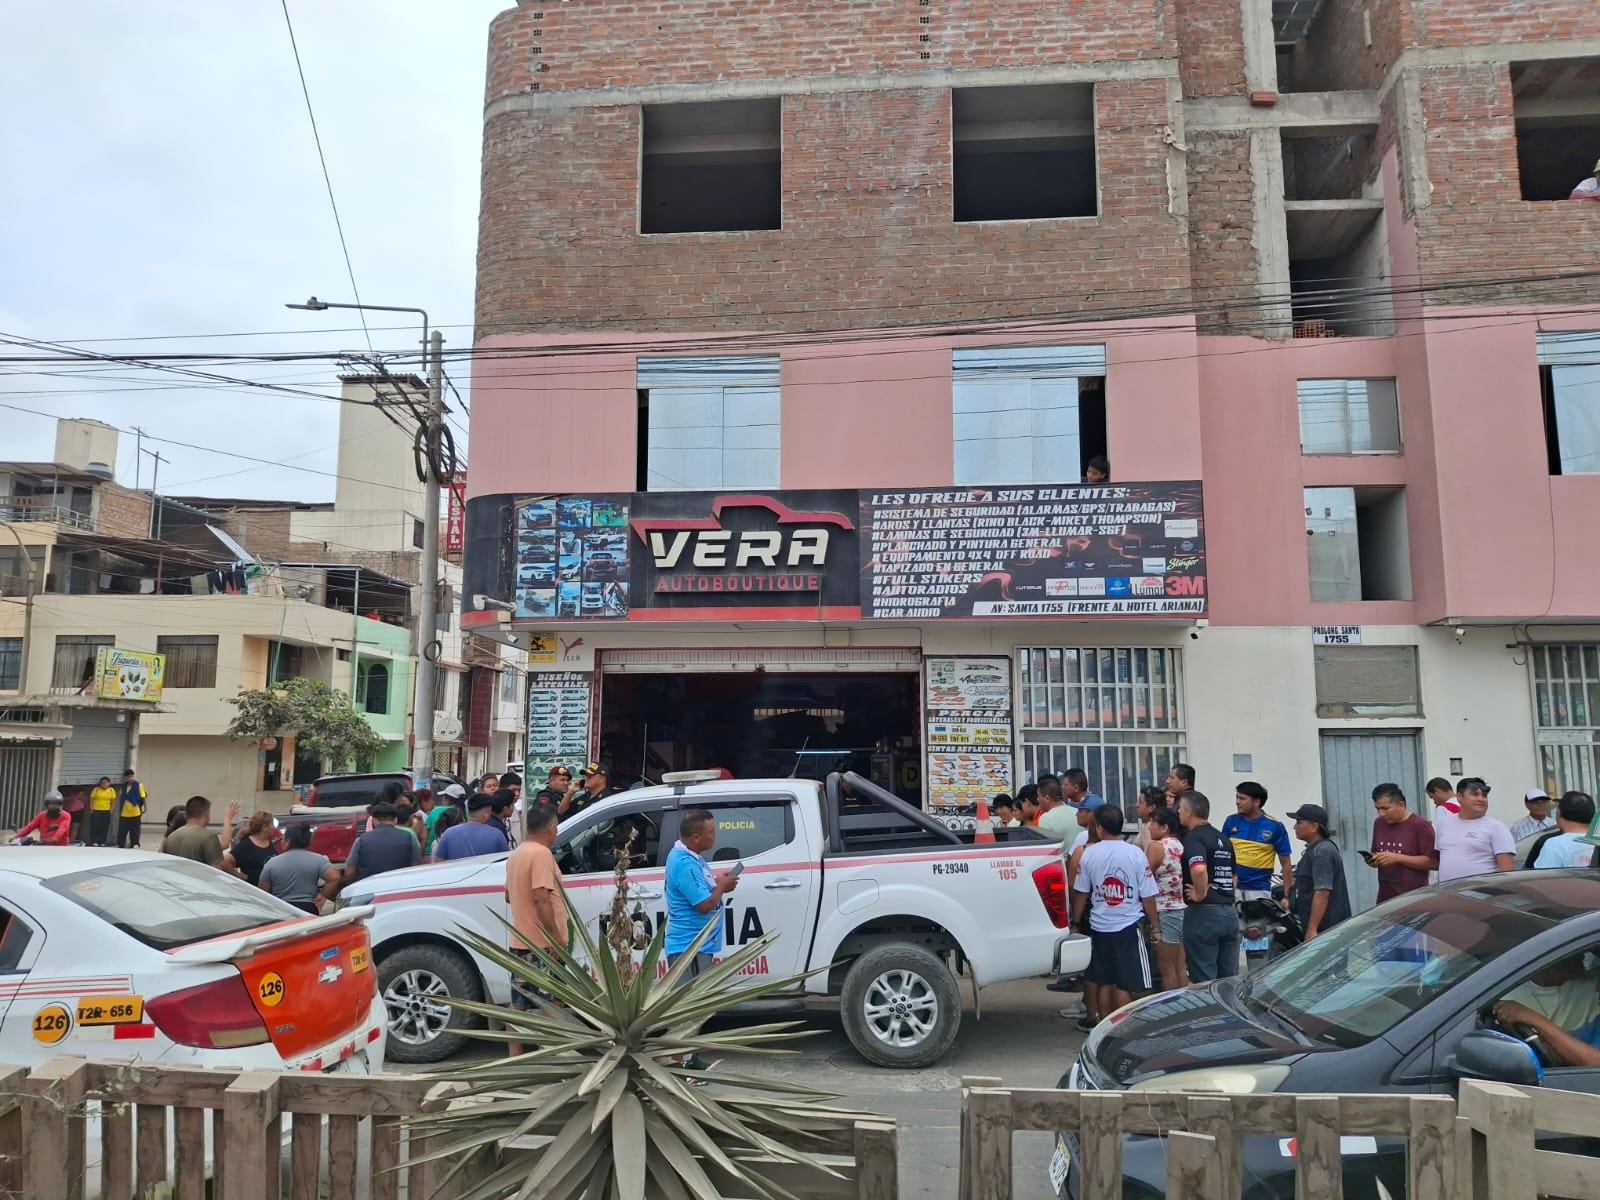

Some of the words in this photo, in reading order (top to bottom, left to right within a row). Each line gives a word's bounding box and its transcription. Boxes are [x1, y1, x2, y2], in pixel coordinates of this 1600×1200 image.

[872, 494, 905, 505] LES
[908, 492, 976, 504] OFRECE
[982, 490, 992, 502] A
[997, 490, 1034, 501] SUS
[1038, 487, 1130, 500] CLIENTES:
[873, 508, 932, 520] #SISTEMA
[932, 508, 948, 518] DE
[950, 506, 1015, 518] SEGURIDAD
[872, 520, 910, 530] #AROS
[912, 520, 921, 529] Y
[922, 518, 970, 528] LLANTAS
[973, 517, 1006, 528] (RINO
[1092, 512, 1162, 525] THOMPSON)
[932, 529, 948, 540] DE
[950, 528, 1015, 539] SEGURIDAD
[649, 528, 830, 568] VERA
[872, 540, 948, 552] #PLANCHADO
[950, 540, 958, 550] Y
[958, 539, 1009, 550] PINTURA
[1010, 538, 1062, 548] GENERAL
[882, 551, 965, 563] EQUIPAMIENTO
[968, 550, 991, 560] 4X4
[996, 550, 1017, 560] OFF
[1020, 550, 1051, 559] ROAD
[1166, 556, 1200, 570] Stinger
[872, 563, 934, 574] #TAPIZADO
[936, 562, 951, 572] EN
[952, 562, 1006, 572] GENERAL
[656, 575, 819, 592] AUTOBOUTIQUE
[872, 574, 917, 586] #FULL
[920, 573, 984, 584] STIKERS
[1166, 576, 1204, 596] 3M
[872, 584, 969, 596] #AUTORADIOS
[908, 607, 940, 618] AUDIO
[991, 604, 1006, 614] AV:
[1008, 604, 1038, 613] SANTA
[1041, 603, 1063, 612] 1755
[1068, 602, 1110, 614] (FRENTE
[1112, 602, 1124, 612] AL
[1126, 602, 1158, 612] HOTEL
[1160, 601, 1202, 612] ARIANA)
[1325, 635, 1349, 643] 1755
[719, 820, 755, 830] POLICIA
[932, 862, 969, 875] PG-29340
[998, 868, 1018, 880] 105
[260, 980, 282, 998] 126
[77, 1004, 133, 1020] T2R-656
[34, 1014, 66, 1031] 126
